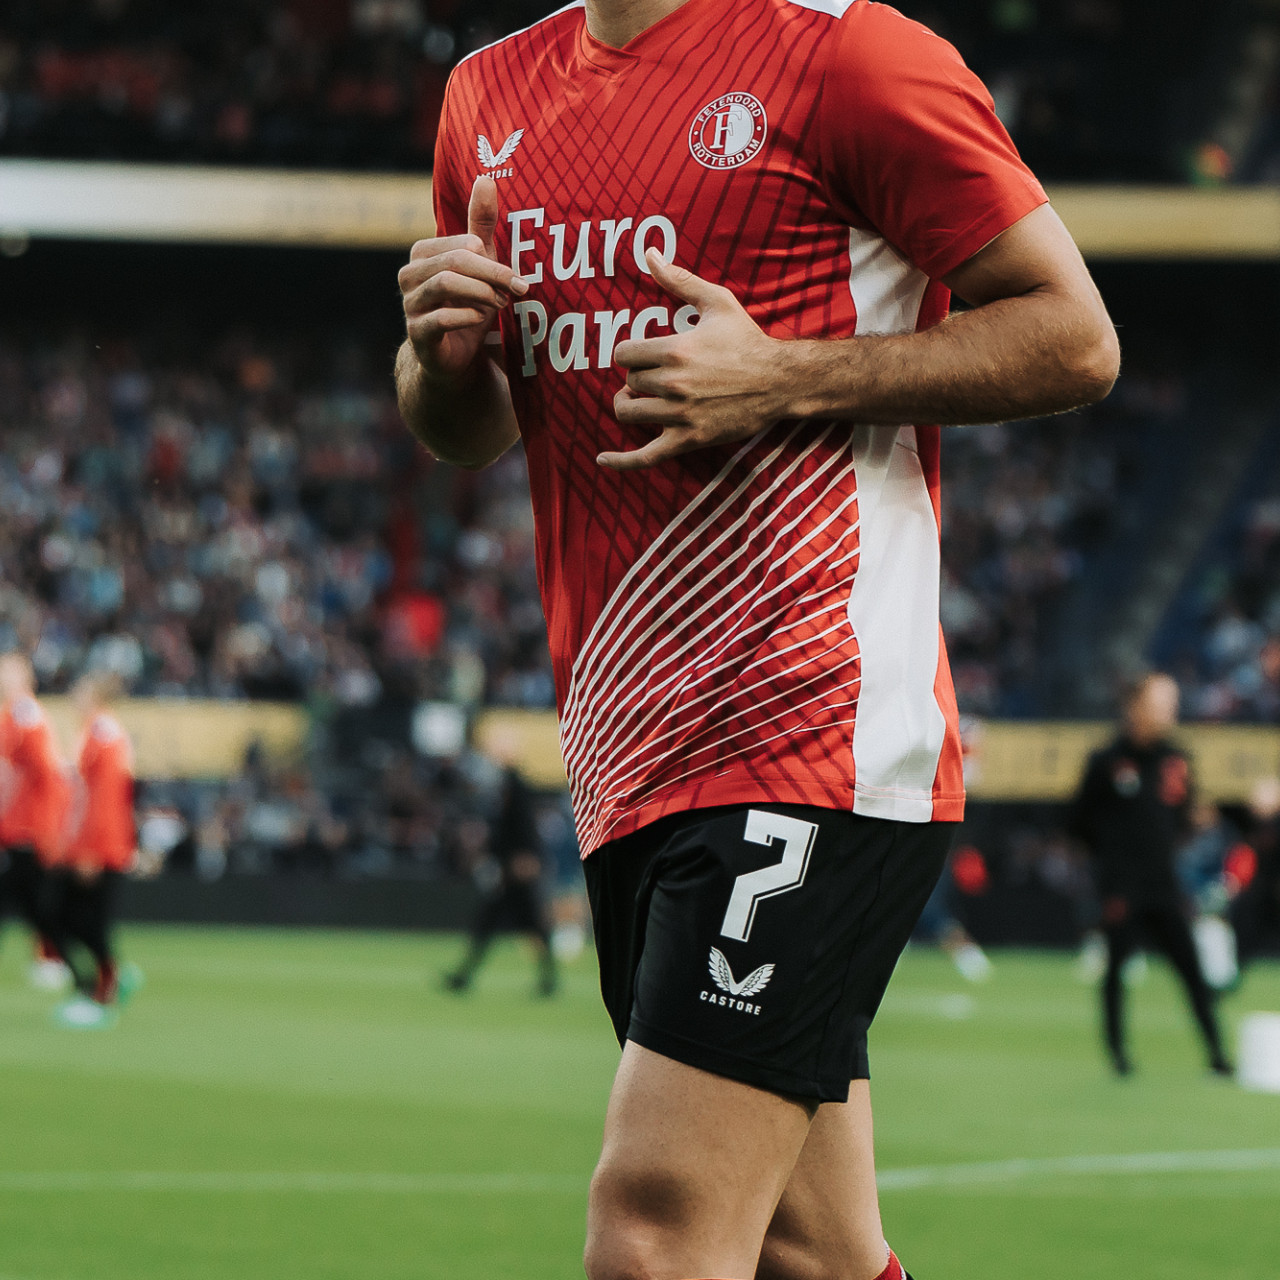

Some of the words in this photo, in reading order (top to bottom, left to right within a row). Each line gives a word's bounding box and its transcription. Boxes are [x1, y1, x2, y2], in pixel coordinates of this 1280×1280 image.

[697, 94, 762, 123] FEYENOORD
[709, 110, 743, 149] F
[692, 137, 761, 167] ROTTERDAM
[507, 207, 678, 285] Euro
[720, 809, 820, 942] 7
[699, 989, 763, 1016] CASTORE
